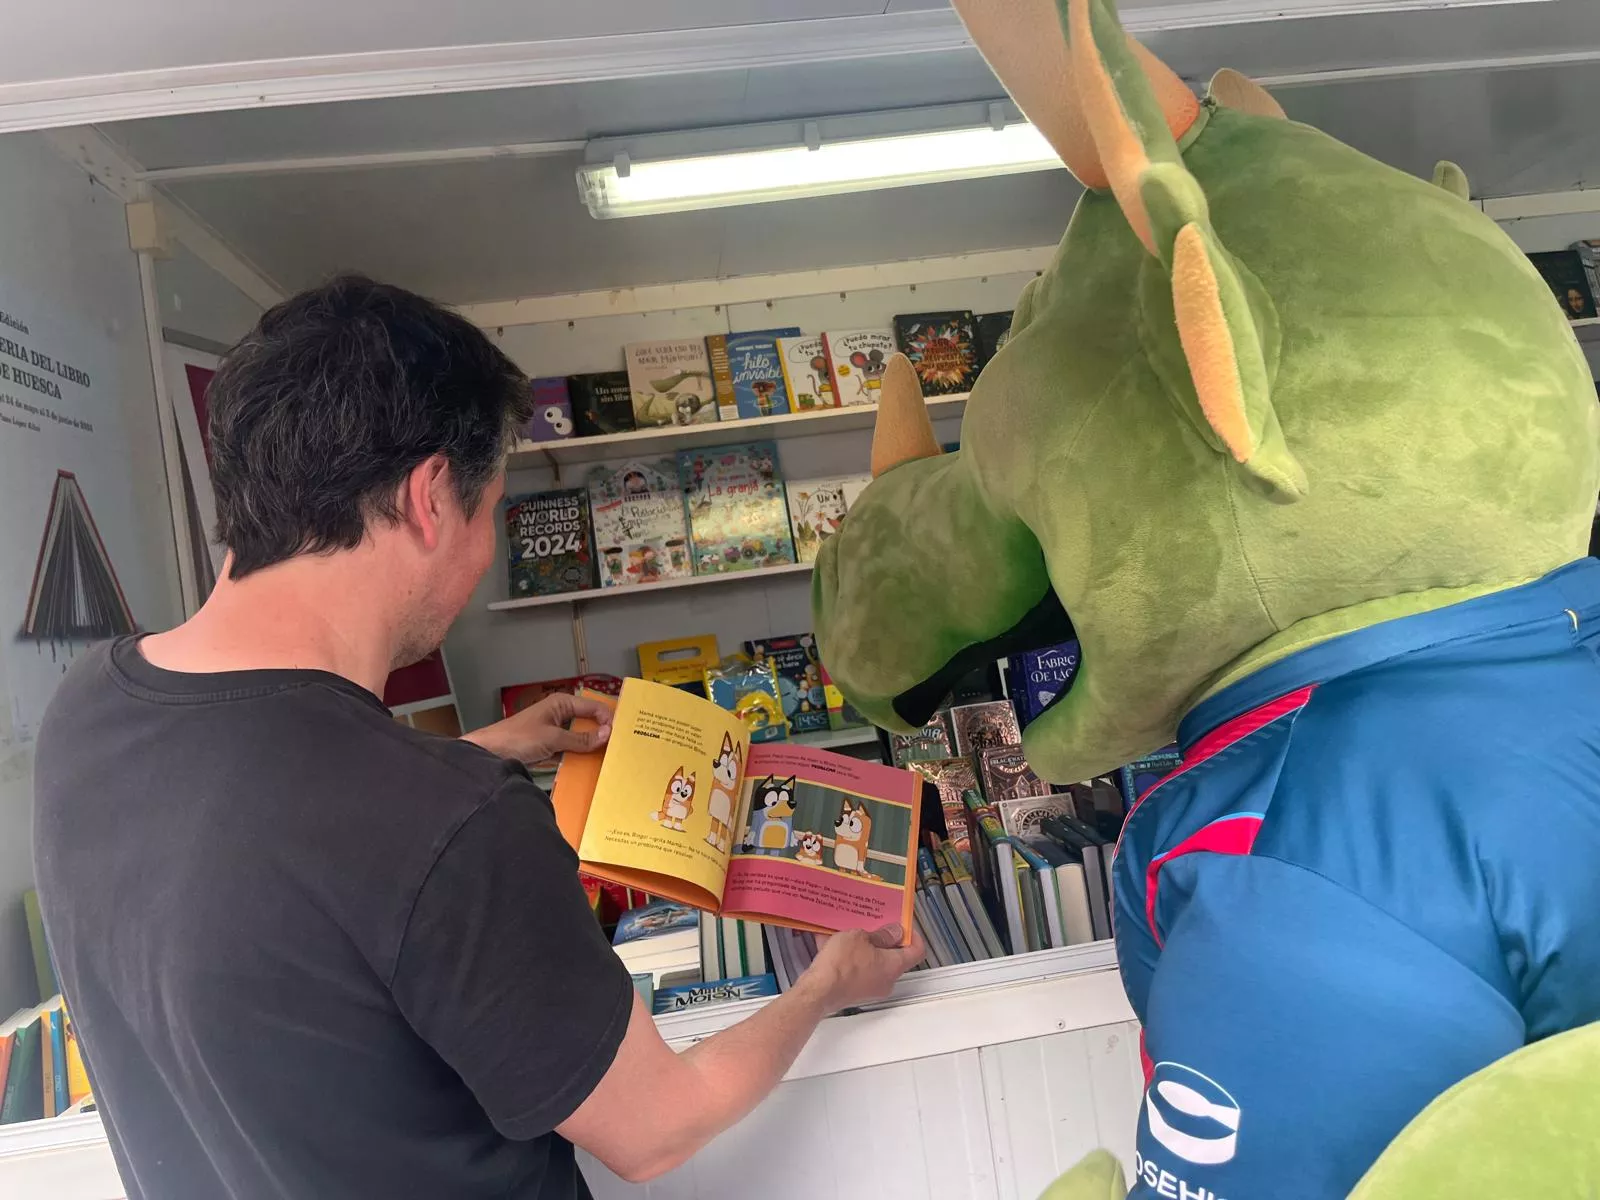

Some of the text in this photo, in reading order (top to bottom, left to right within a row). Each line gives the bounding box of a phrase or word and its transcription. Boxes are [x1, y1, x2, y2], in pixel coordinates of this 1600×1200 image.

[870, 333, 891, 342] mirar
[31, 350, 55, 373] DEL
[56, 361, 91, 388] LIBRO
[744, 351, 770, 370] hilo
[0, 362, 62, 400] E HUESCA
[708, 480, 759, 499] La granja
[520, 496, 579, 512] GUINNESS
[519, 507, 580, 525] WORLD
[520, 520, 580, 537] RECORDS
[520, 532, 580, 559] 2024
[1031, 671, 1050, 683] DE
[633, 728, 660, 741] PROBLEMA
[811, 764, 836, 773] PROBLEMA
